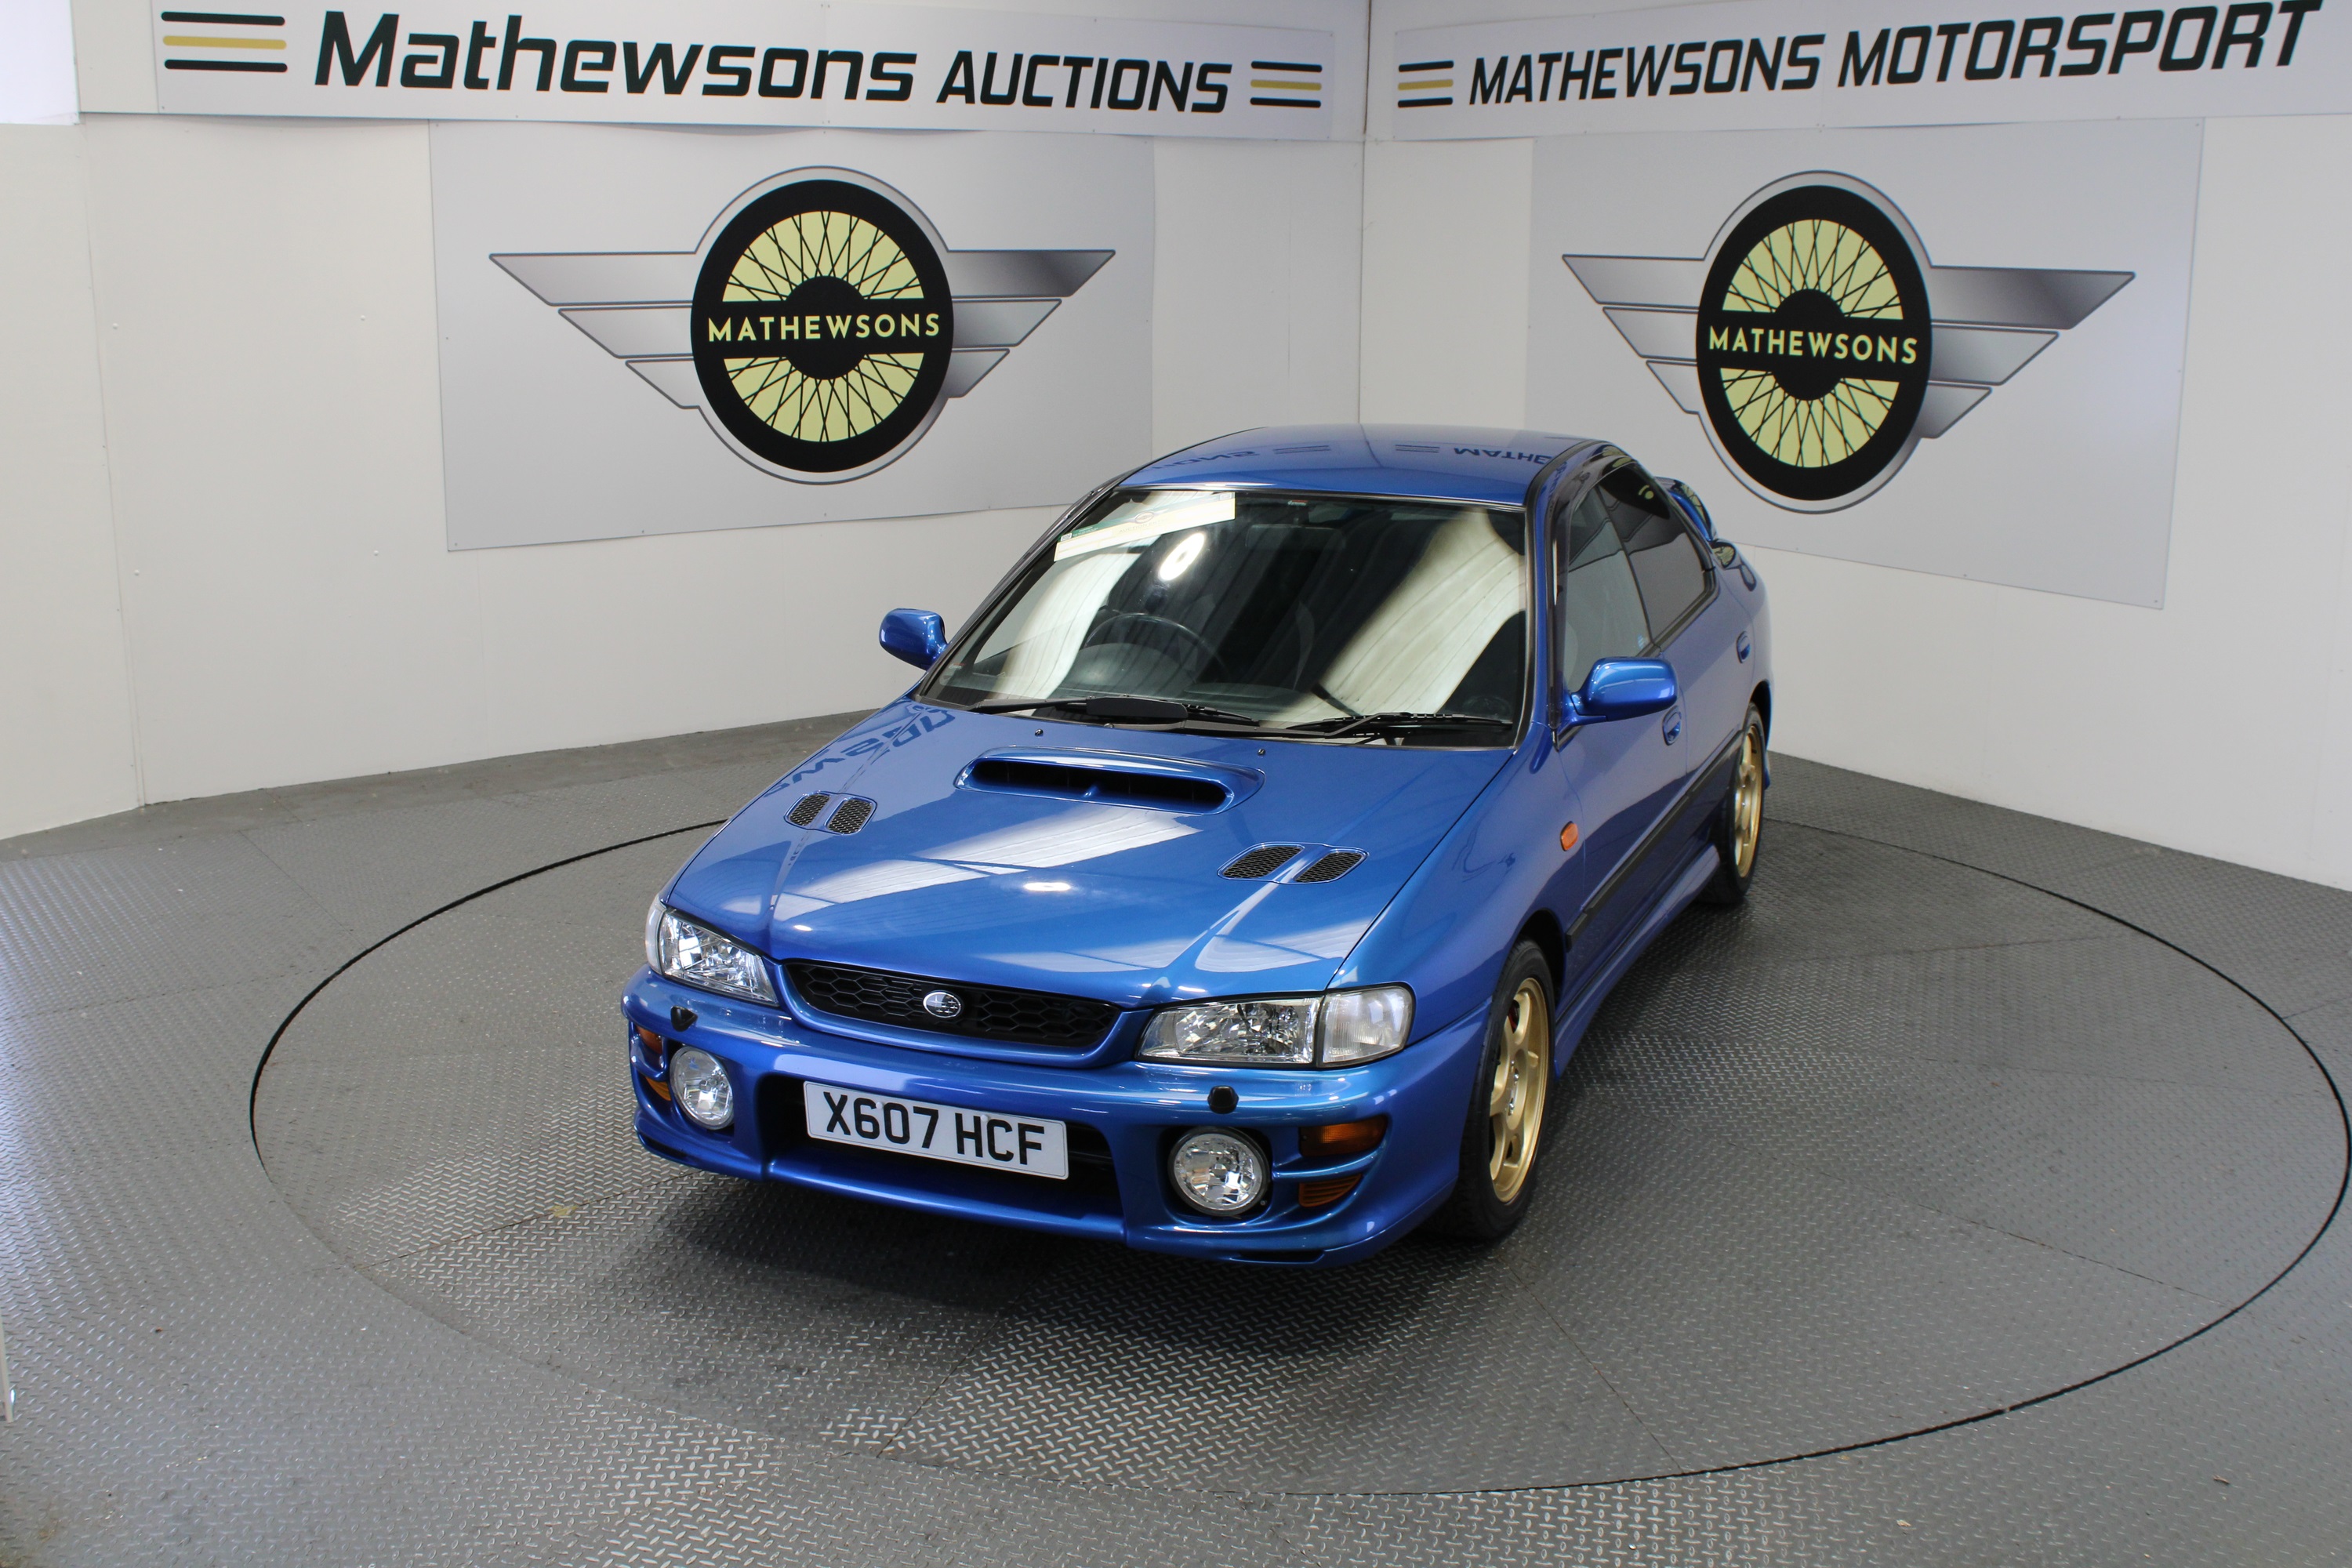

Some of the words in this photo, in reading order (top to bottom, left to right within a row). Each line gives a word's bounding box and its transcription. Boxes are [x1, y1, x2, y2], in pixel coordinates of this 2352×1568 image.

[315, 11, 917, 102] Mathewsons
[937, 50, 1232, 114] AUCTIONS
[1469, 34, 1824, 105] MATHEWSONS
[1838, 0, 2324, 88] MOTORSPORT
[708, 313, 940, 343] MATHEWSONS
[1709, 325, 1918, 365] MATHEWSONS
[823, 1091, 939, 1149] X607
[955, 1112, 1045, 1166] HCF
